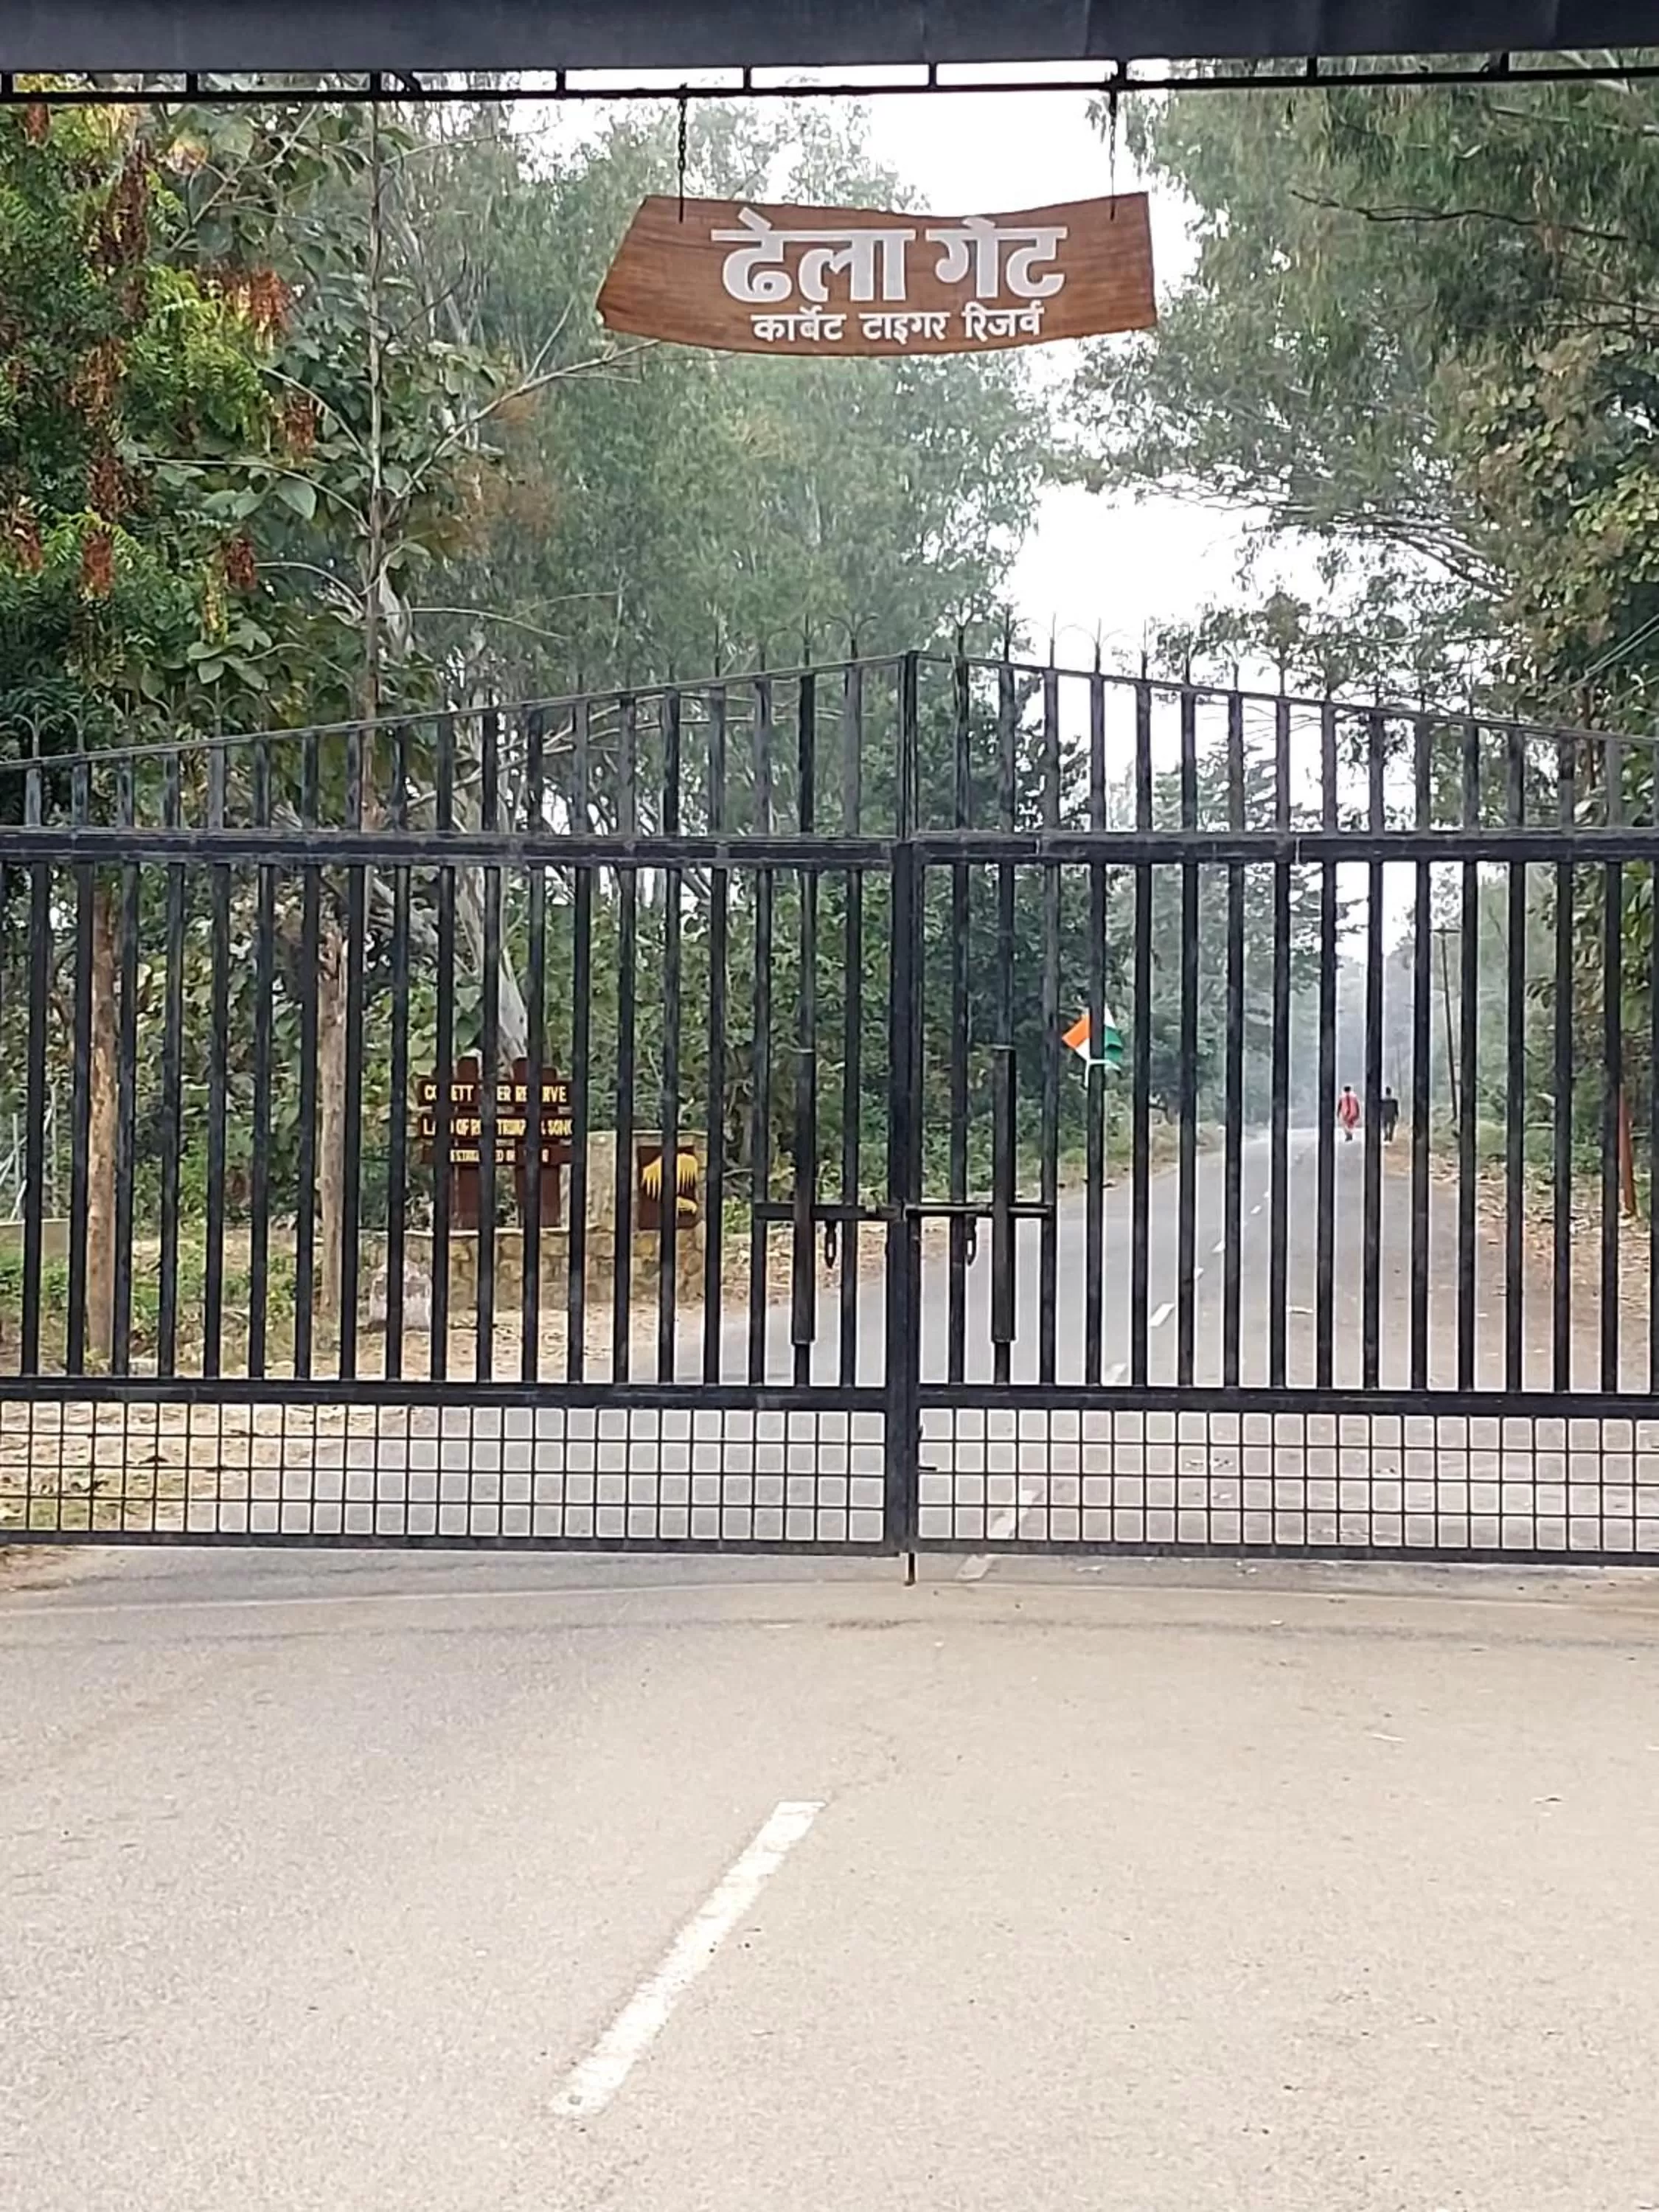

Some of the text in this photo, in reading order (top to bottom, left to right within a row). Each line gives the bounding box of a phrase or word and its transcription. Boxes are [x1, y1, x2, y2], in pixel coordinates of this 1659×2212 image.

[711, 207, 1068, 303] ढेला गेट
[858, 311, 951, 345] टाइगर
[961, 299, 1045, 342] रिजर्व
[424, 1085, 474, 1102] COETT
[515, 1085, 567, 1102] RERVE
